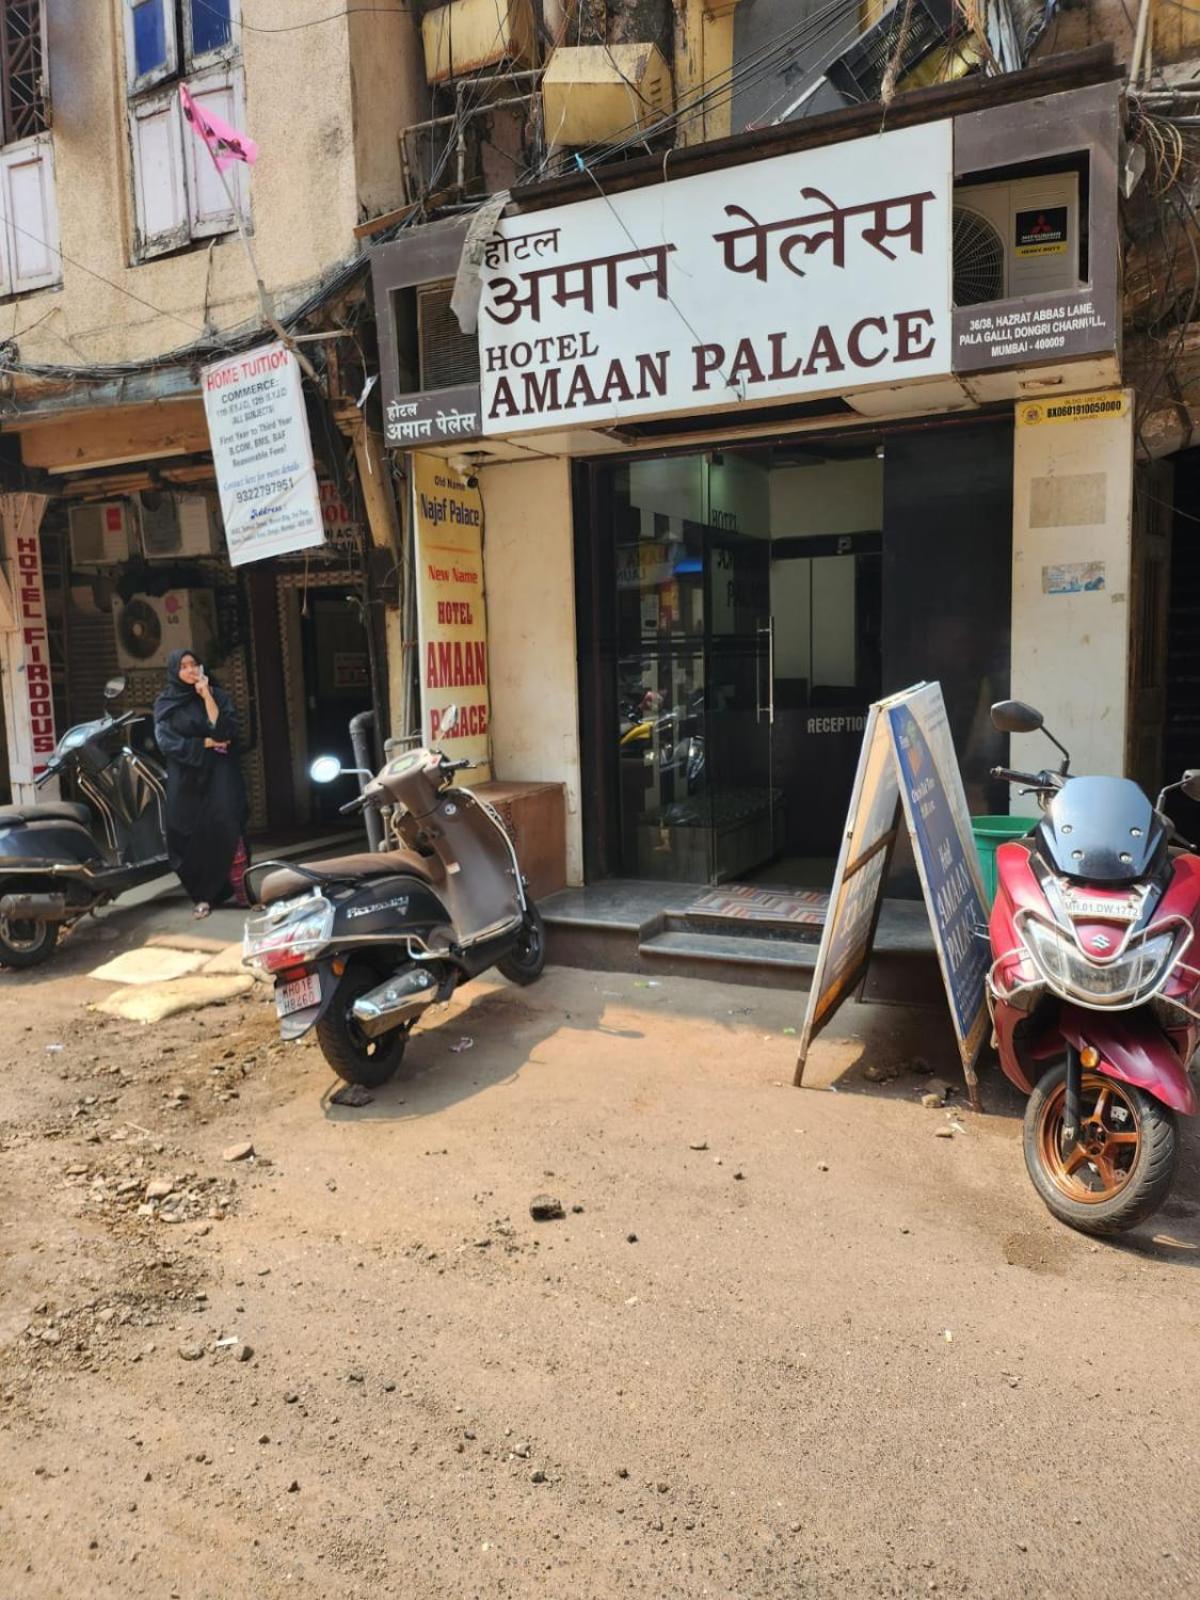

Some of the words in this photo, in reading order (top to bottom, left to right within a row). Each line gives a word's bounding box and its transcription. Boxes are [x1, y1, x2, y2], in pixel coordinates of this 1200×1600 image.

[484, 228, 561, 269] होटल
[484, 243, 678, 325] अमान
[711, 186, 937, 282] पेलेस
[969, 318, 994, 331] 36/38,
[996, 312, 1031, 327] HAZRAT
[1033, 307, 1066, 321] ABBAS
[1067, 302, 1095, 316] LANE,
[485, 331, 599, 372] HOTEL
[959, 333, 983, 346] PALA
[984, 329, 1013, 343] GALLI,
[1014, 324, 1051, 338] DONGRI
[991, 341, 1028, 357] MUMBAI
[1034, 336, 1065, 350] 400009
[207, 367, 239, 390] HOME
[241, 350, 288, 379] TUITION
[488, 351, 671, 419] AMAAN
[692, 309, 937, 392] PALACE
[386, 400, 418, 422] होटल
[386, 419, 432, 440] अमान
[436, 408, 477, 434] पेलेस
[434, 474, 447, 487] Old
[447, 477, 466, 490] Name
[420, 493, 447, 527] Najaf
[449, 499, 480, 527] Palace
[17, 537, 42, 618] HOTEL
[428, 564, 449, 581] New
[452, 567, 479, 584] Name
[437, 600, 473, 625] HOTEL
[427, 641, 487, 688] AMAAN
[23, 627, 54, 753] FIRDOUS
[807, 715, 867, 734] RECEPTIO
